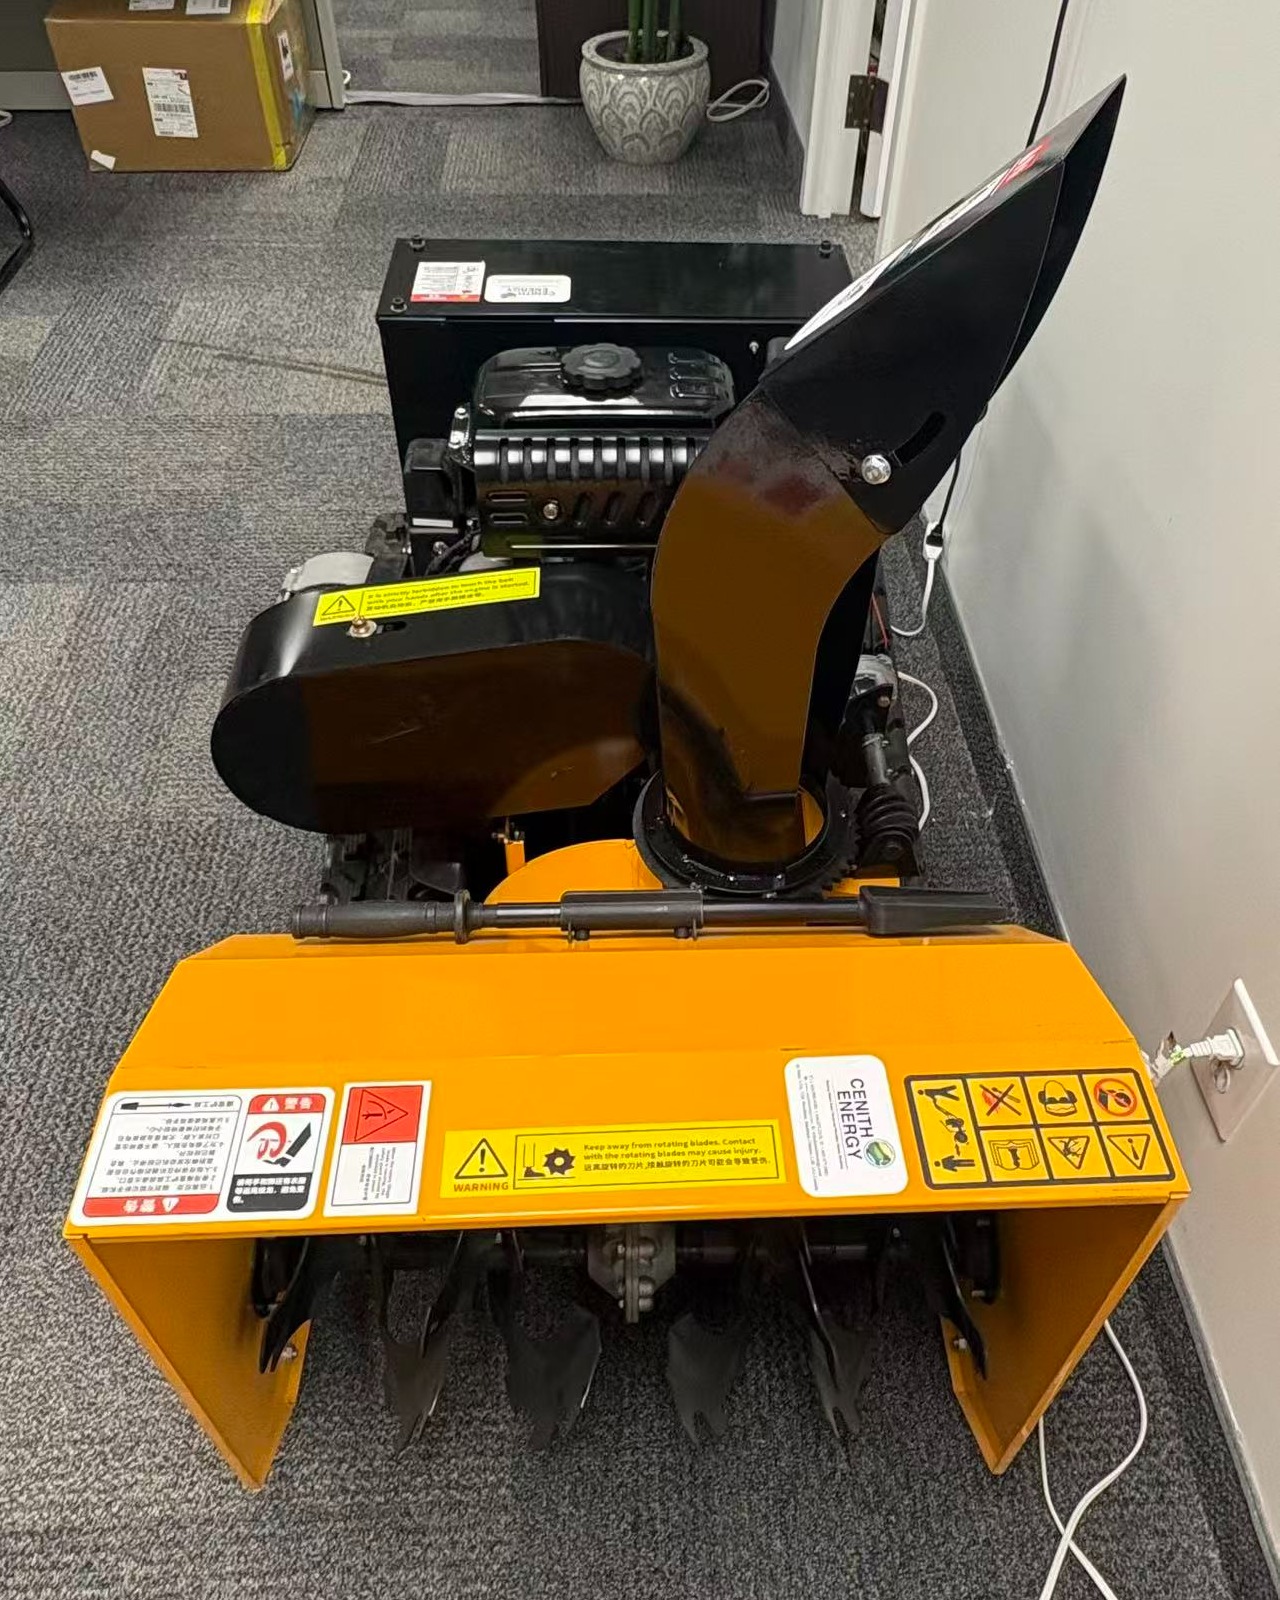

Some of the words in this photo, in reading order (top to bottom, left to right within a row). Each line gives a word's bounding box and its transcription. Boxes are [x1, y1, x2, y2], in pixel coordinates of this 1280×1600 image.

[850, 1078, 874, 1138] CENITH
[837, 1090, 862, 1160] ENERGY
[584, 1144, 606, 1152] Keep
[606, 1143, 630, 1151] away
[631, 1142, 652, 1150] from
[654, 1140, 688, 1149] rotating
[690, 1139, 720, 1147] blades.
[722, 1138, 756, 1146] Contact
[584, 1152, 603, 1160] with
[605, 1152, 619, 1160] the
[620, 1150, 656, 1160] rotating
[657, 1150, 686, 1158] blades
[687, 1150, 706, 1158] may
[733, 1147, 762, 1156] injury.
[454, 1182, 509, 1192] WARNING
